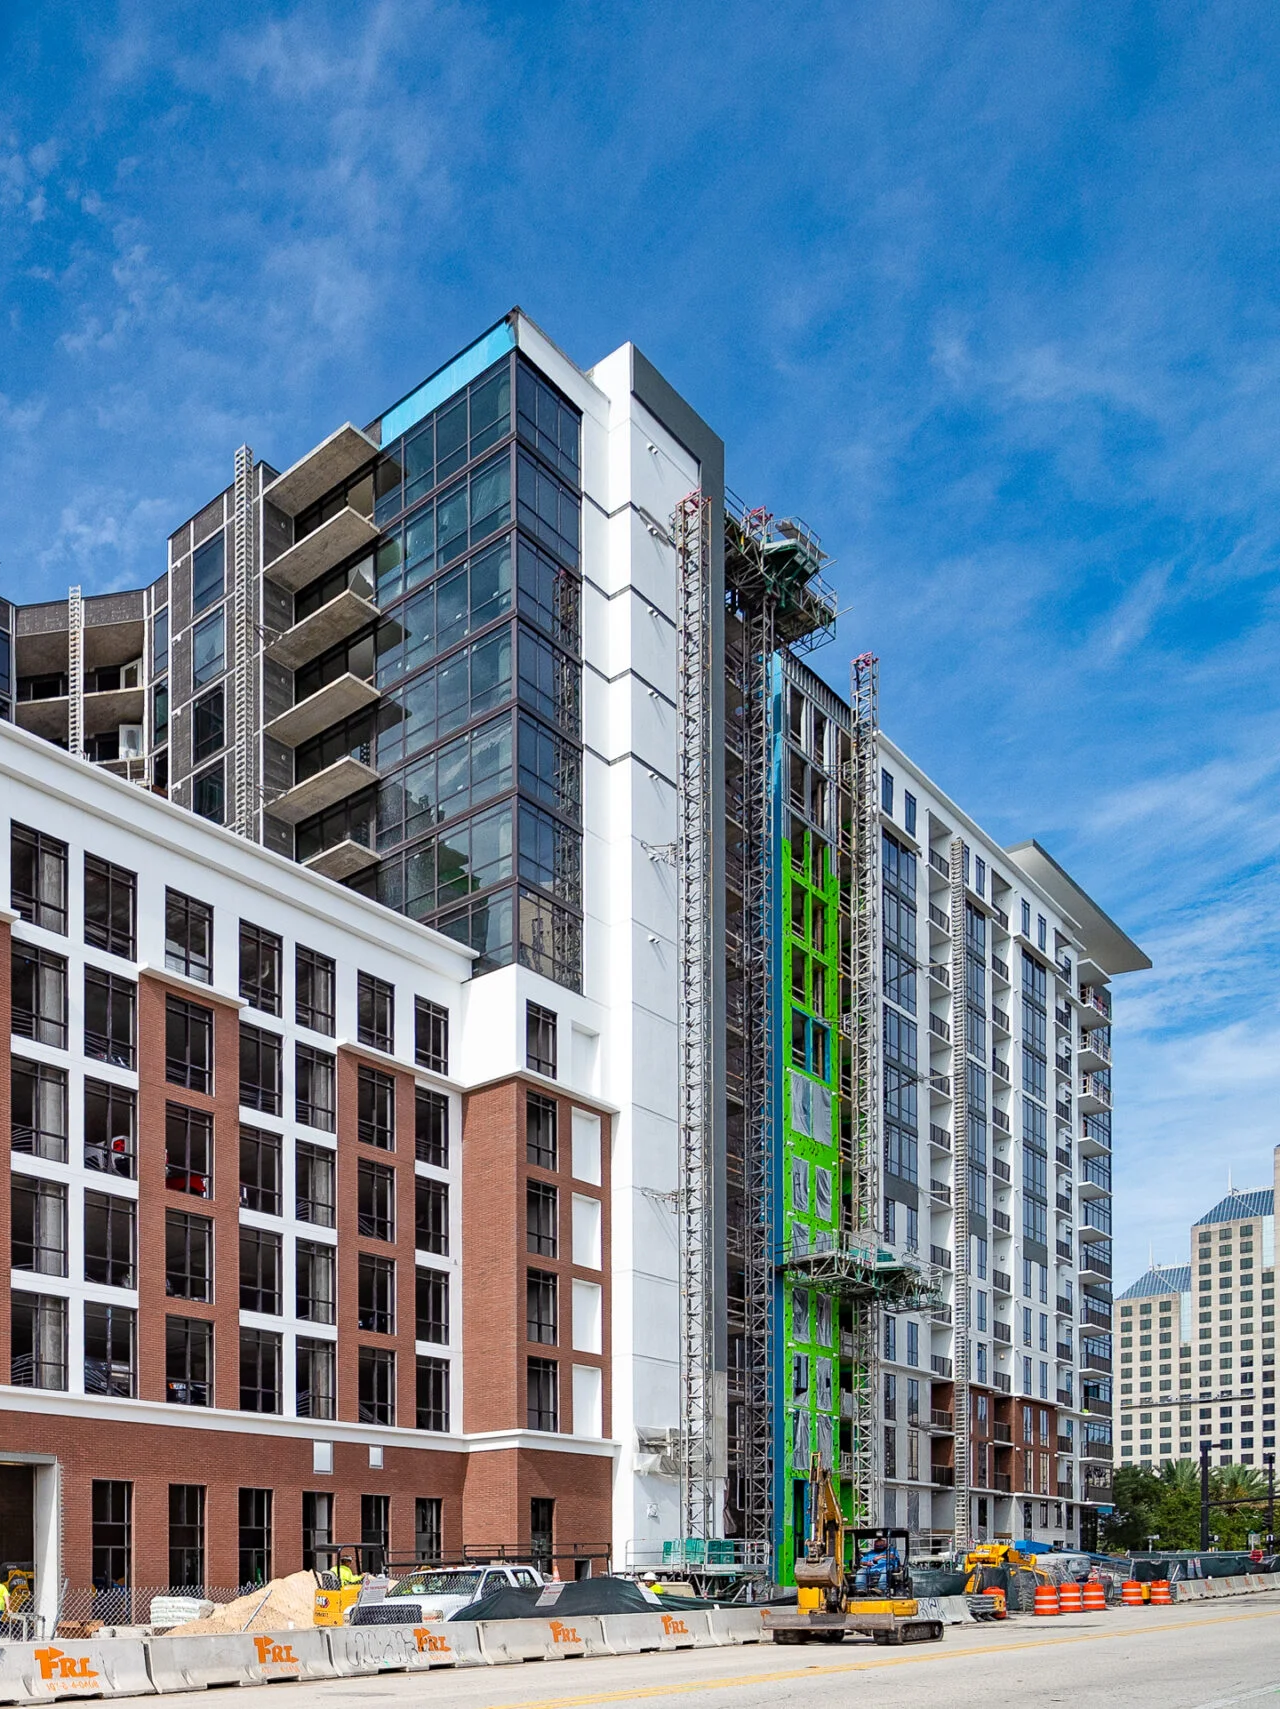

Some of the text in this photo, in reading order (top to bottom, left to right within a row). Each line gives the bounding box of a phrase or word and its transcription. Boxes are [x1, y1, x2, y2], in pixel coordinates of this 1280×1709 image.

[549, 1620, 582, 1643] FRL
[661, 1614, 689, 1635] FRL
[253, 1635, 299, 1664] FRL
[413, 1627, 452, 1652] FRL
[34, 1646, 100, 1680] FRL
